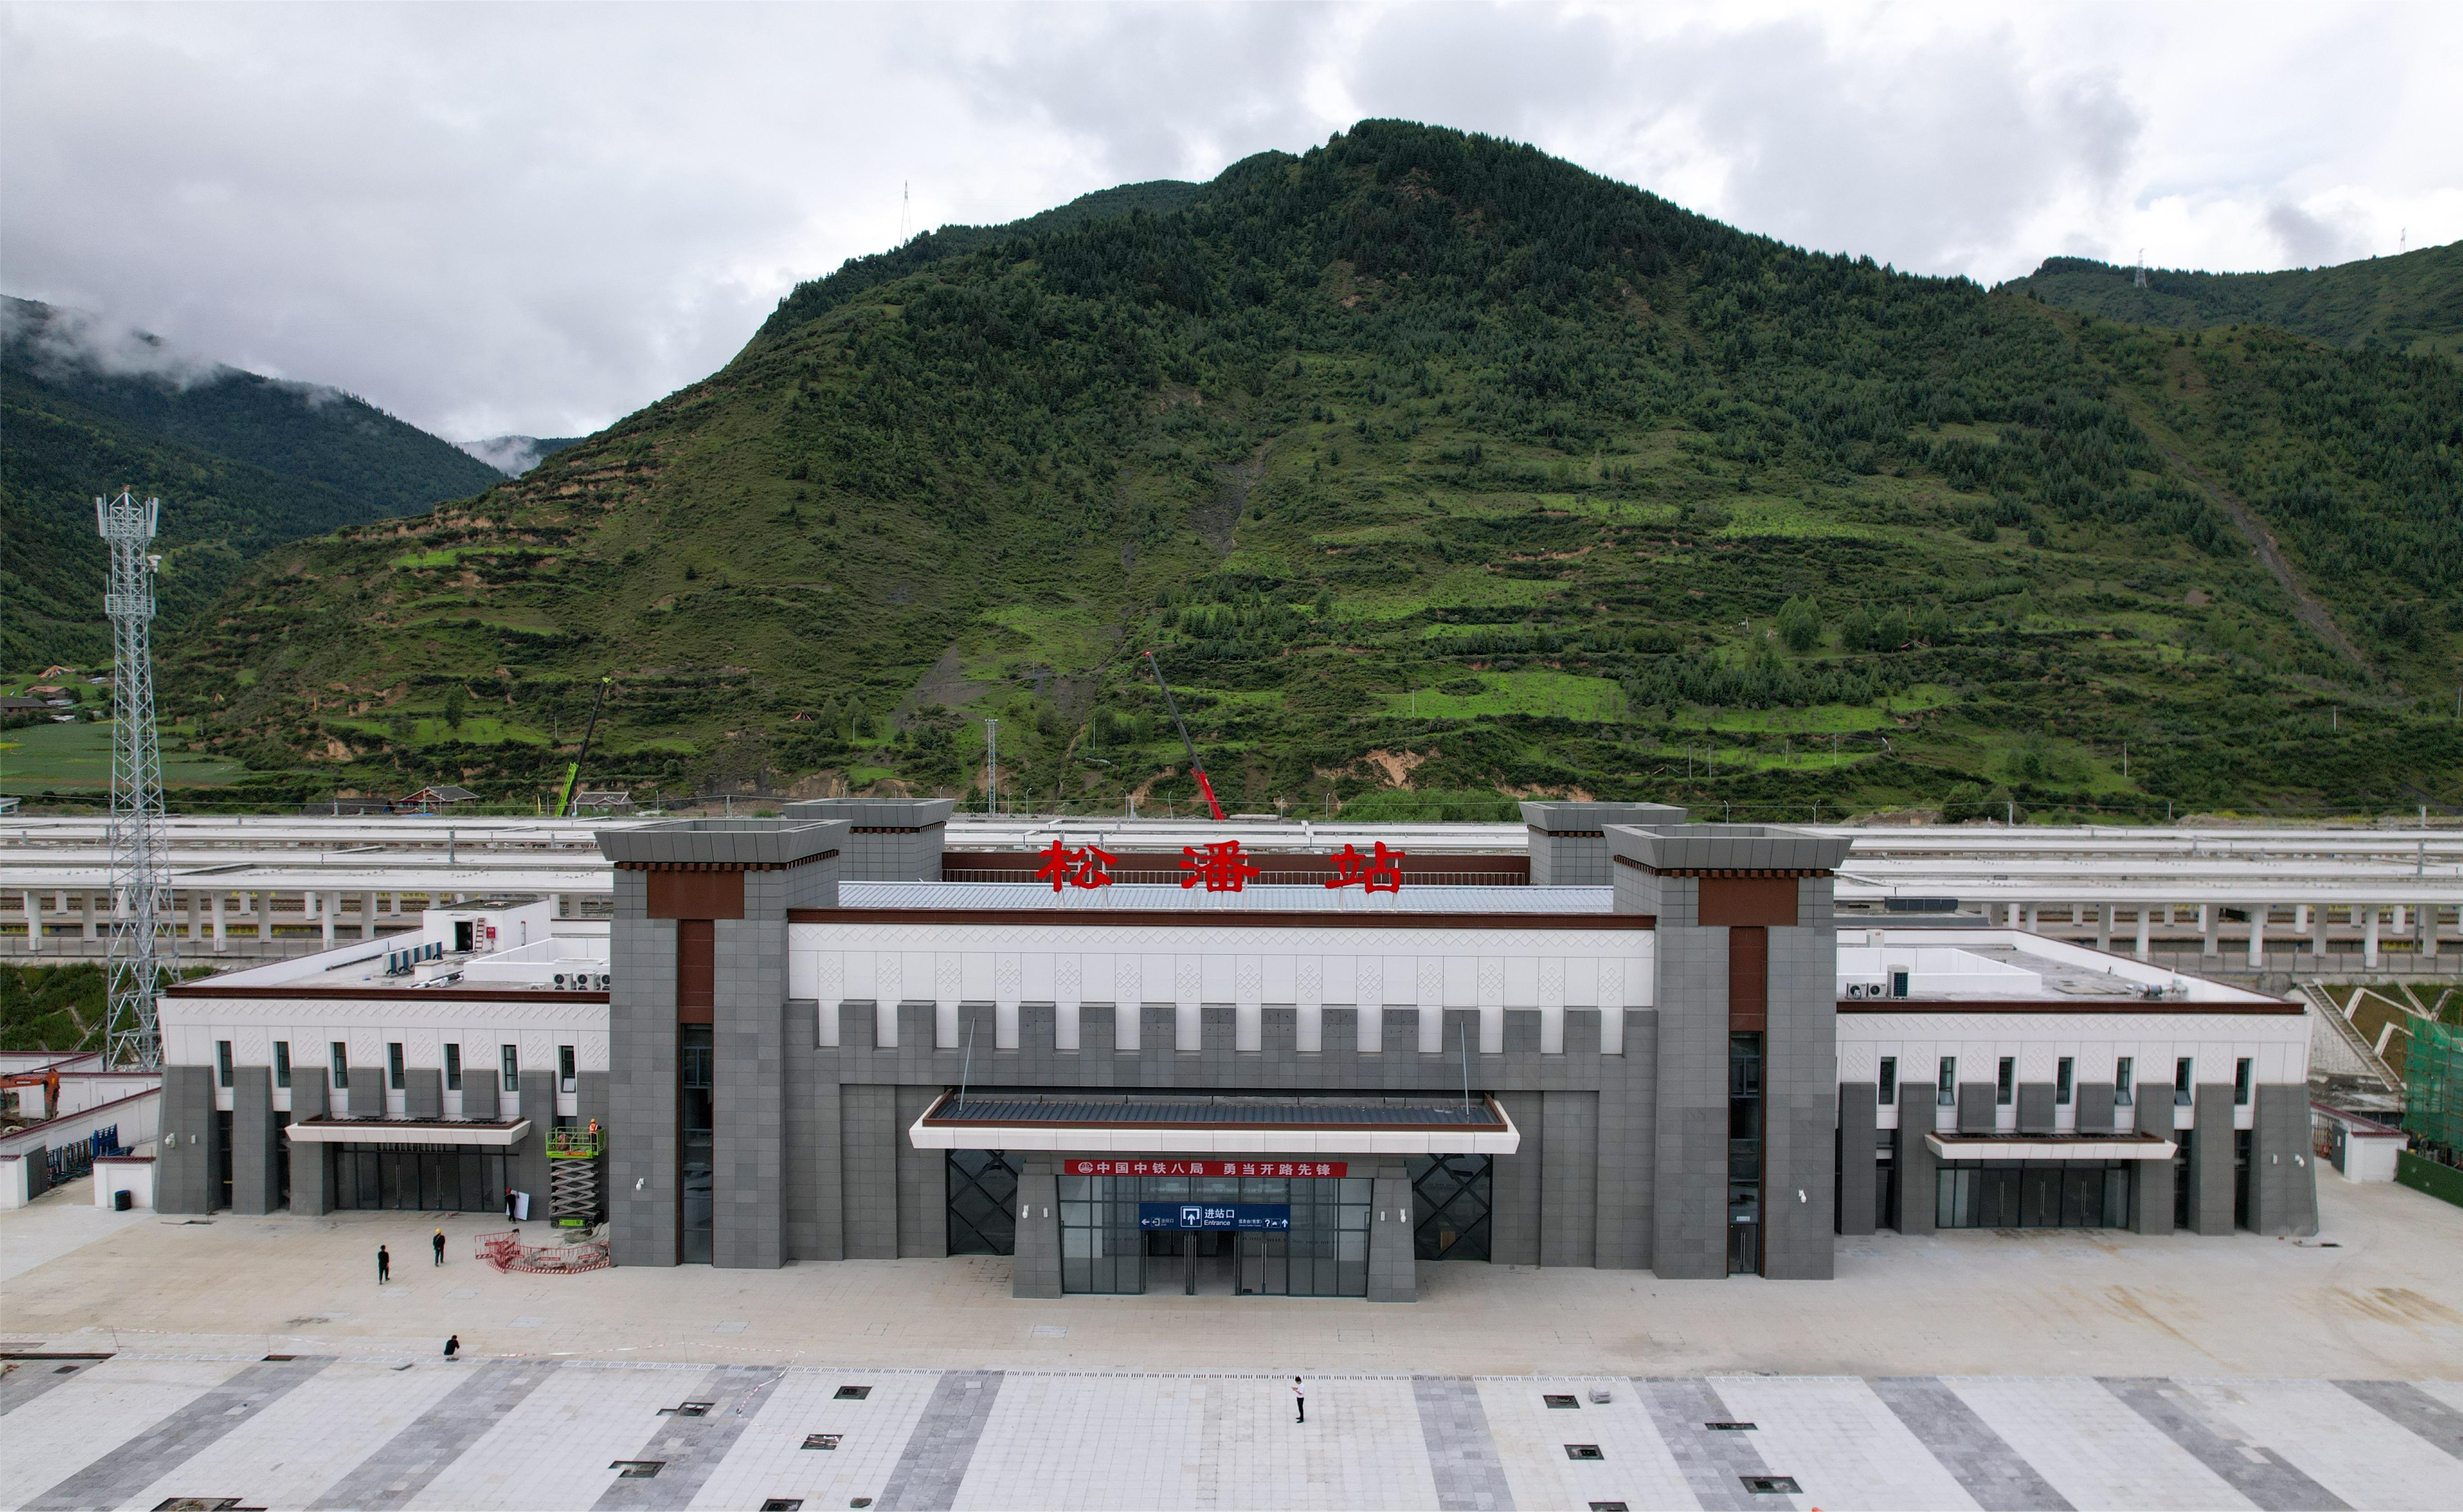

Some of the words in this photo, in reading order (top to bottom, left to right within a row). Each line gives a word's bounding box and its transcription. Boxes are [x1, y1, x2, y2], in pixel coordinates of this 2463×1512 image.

[1035, 840, 1405, 893] 松潘站
[1097, 1162, 1204, 1174] 中国中铁八局
[1223, 1163, 1331, 1176] 勇当开路先锋
[1204, 1209, 1235, 1219] 进站口
